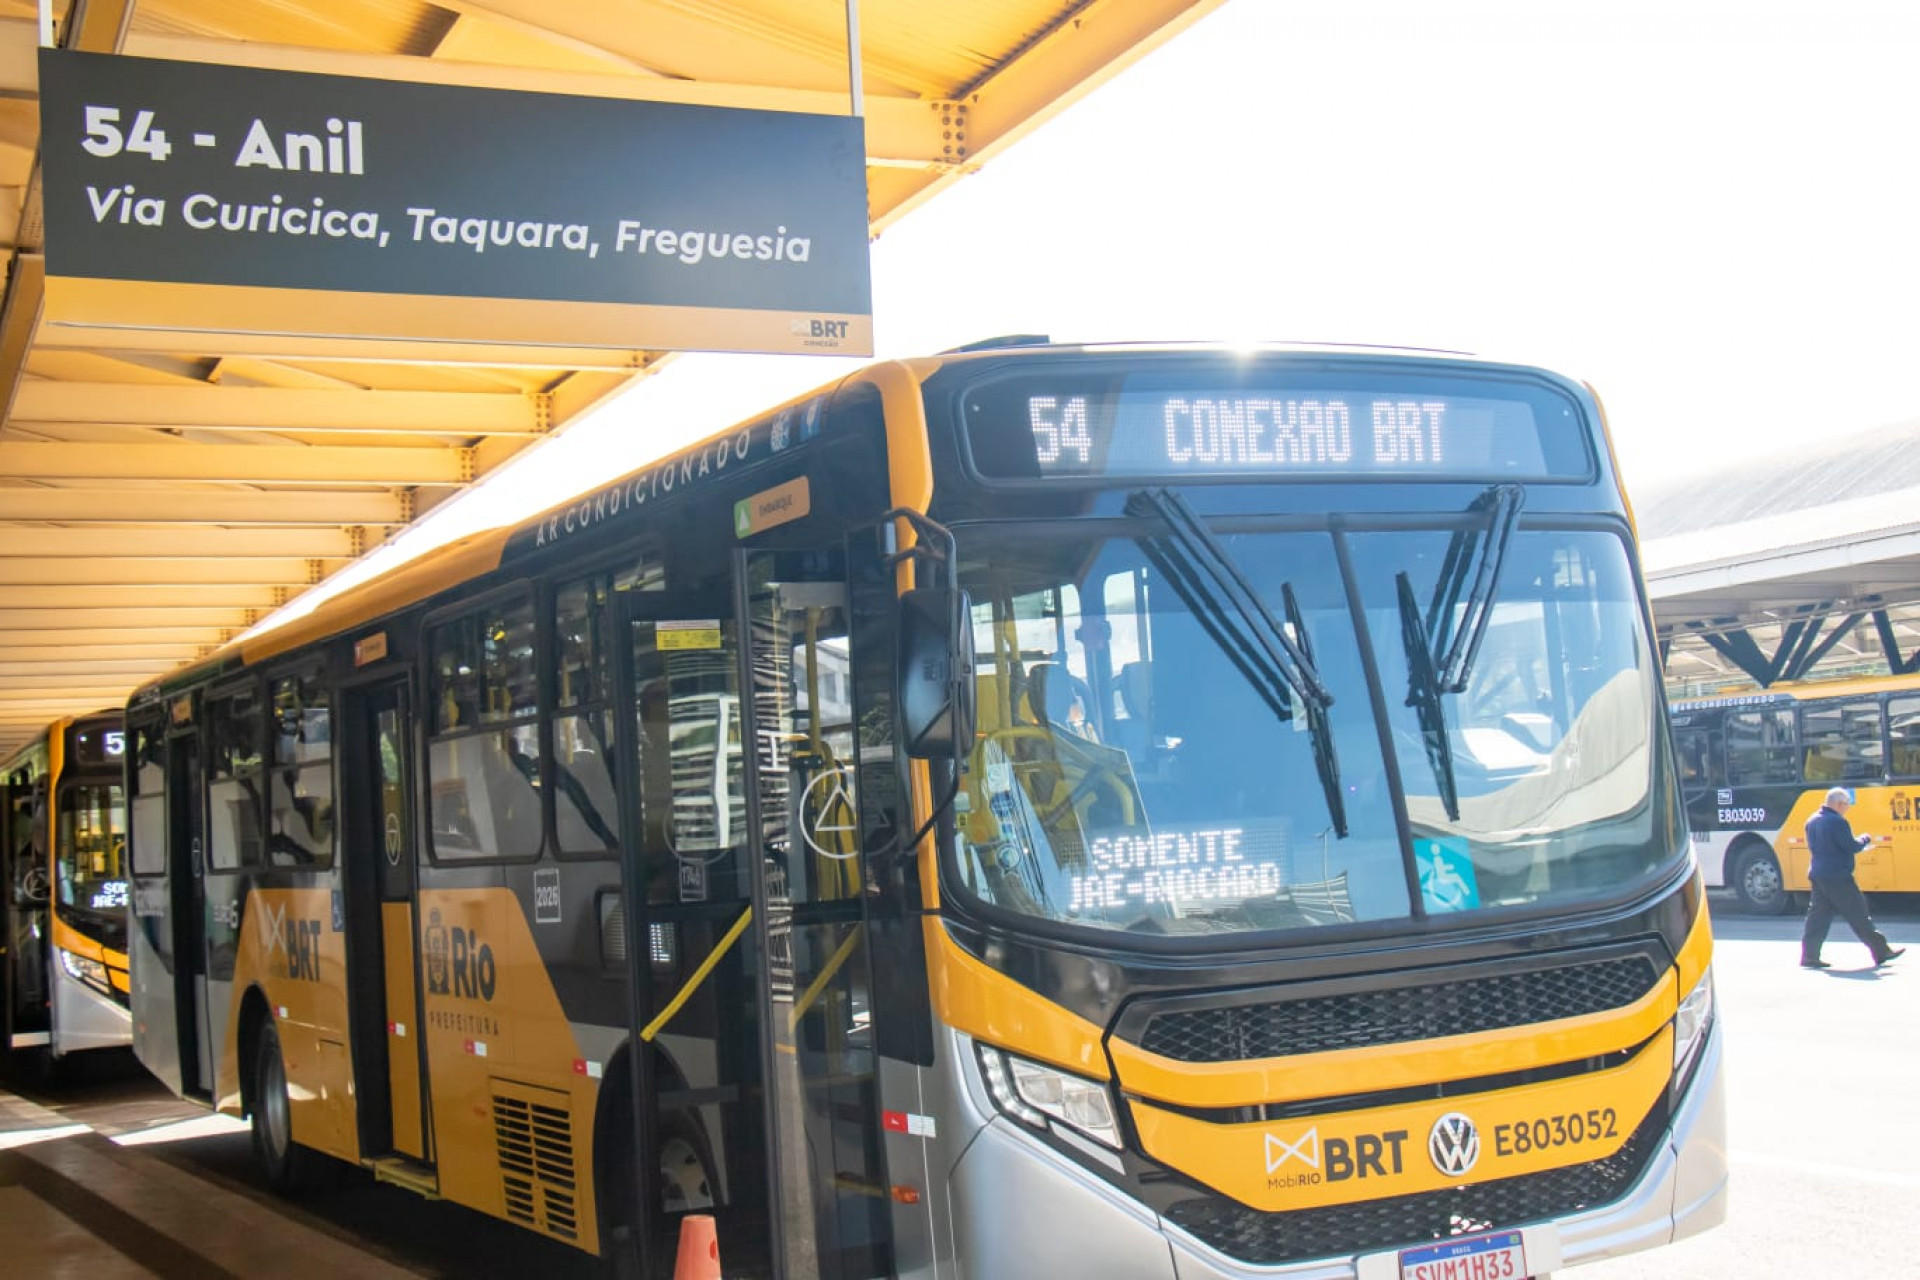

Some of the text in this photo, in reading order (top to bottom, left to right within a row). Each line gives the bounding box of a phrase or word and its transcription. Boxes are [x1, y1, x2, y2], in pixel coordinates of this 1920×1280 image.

[82, 106, 364, 175] 54 - Anil
[86, 184, 811, 265] Via Curicica, Taquara, Freguesia
[810, 319, 849, 338] BRT
[1029, 396, 1092, 462] 54
[1372, 400, 1446, 462] BRT
[1718, 807, 1765, 823] E803039
[1092, 828, 1244, 871] SOMENTE
[286, 919, 322, 983] BRT
[451, 927, 496, 1003] Rio
[429, 1010, 499, 1036] PREFEITURA
[1323, 1129, 1409, 1183] BRT
[1494, 1107, 1618, 1157] E803052
[1268, 1172, 1321, 1190] MobiRIO
